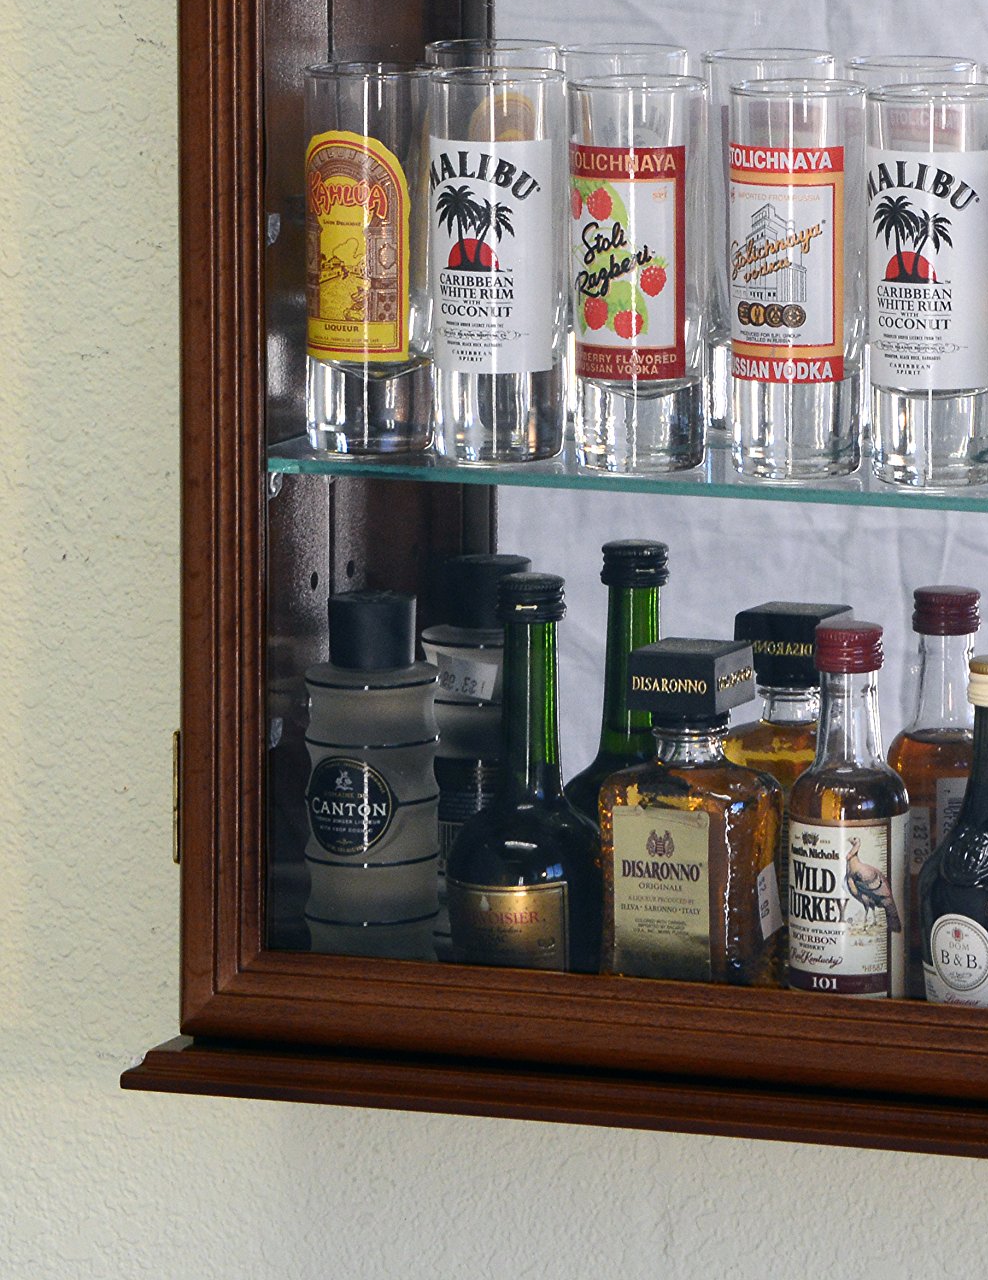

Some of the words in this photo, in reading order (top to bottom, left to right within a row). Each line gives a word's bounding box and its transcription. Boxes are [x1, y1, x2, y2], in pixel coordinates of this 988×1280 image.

[582, 222, 627, 265] Stoli
[439, 272, 514, 288] CARIBBEAN
[440, 285, 478, 300] WHITE
[480, 288, 514, 301] RUM
[876, 285, 953, 300] CARIBBEAN
[441, 303, 513, 318] COCONUT
[877, 297, 915, 312] WHITE
[917, 299, 953, 312] RUM
[324, 324, 360, 334] LIQUEUR
[878, 316, 952, 330] COCONUT
[616, 352, 677, 365] FLAVORED
[617, 363, 659, 376] VODKA
[769, 360, 834, 380] VODKA
[631, 675, 708, 695] DISARONNO
[312, 796, 387, 817] CANTON
[809, 848, 840, 861] Nichols
[621, 859, 701, 882] DISARONNO
[793, 859, 836, 894] WILD
[638, 881, 682, 892] ORIGINALE
[788, 884, 850, 924] TURKEY
[791, 931, 838, 945] BOURBON
[948, 942, 970, 951] DOM
[940, 949, 952, 965] B
[953, 952, 963, 967] &
[965, 954, 978, 969] B
[812, 976, 838, 991] 101
